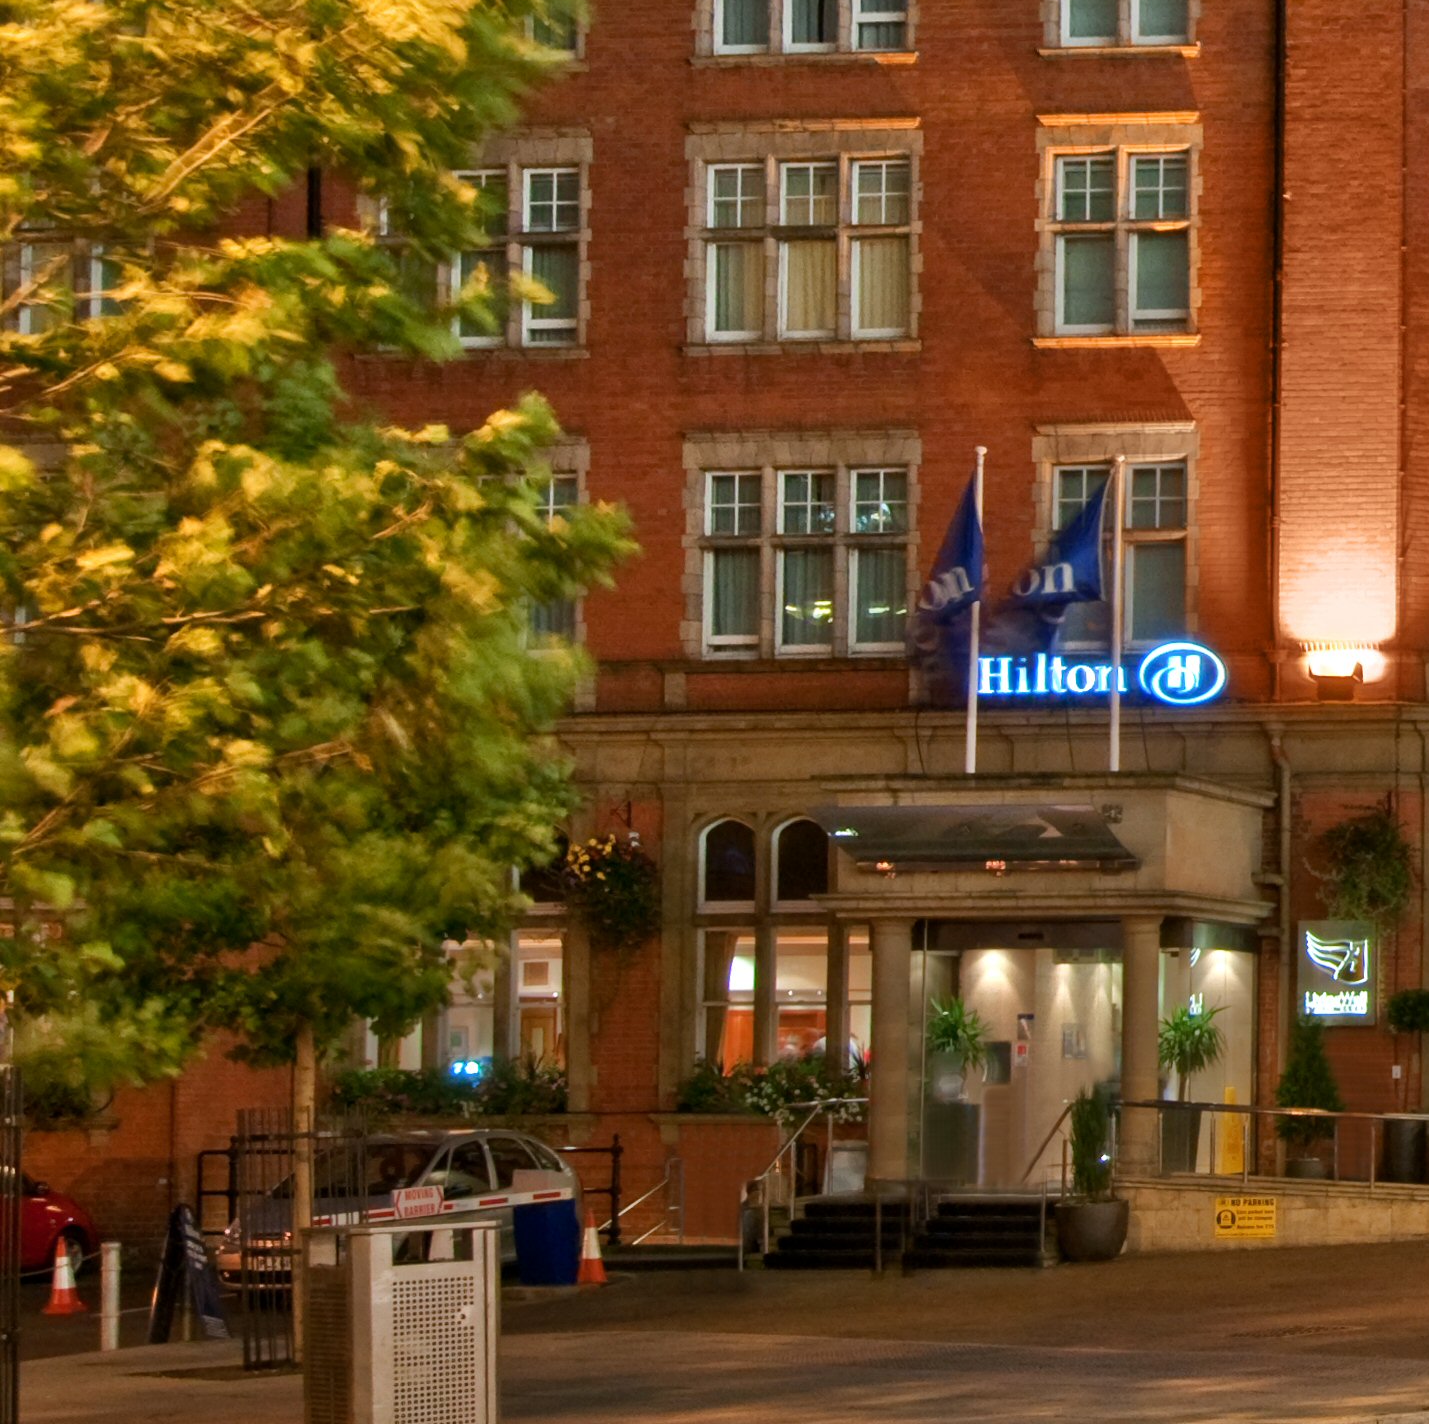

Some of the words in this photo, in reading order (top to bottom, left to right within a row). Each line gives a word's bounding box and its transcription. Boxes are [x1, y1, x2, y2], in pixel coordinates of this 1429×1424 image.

[977, 653, 1127, 694] Hilton
[404, 1187, 434, 1201] MOVING
[1230, 1198, 1241, 1207] NO
[1243, 1198, 1275, 1207] PARKING
[404, 1203, 435, 1217] BARRIER
